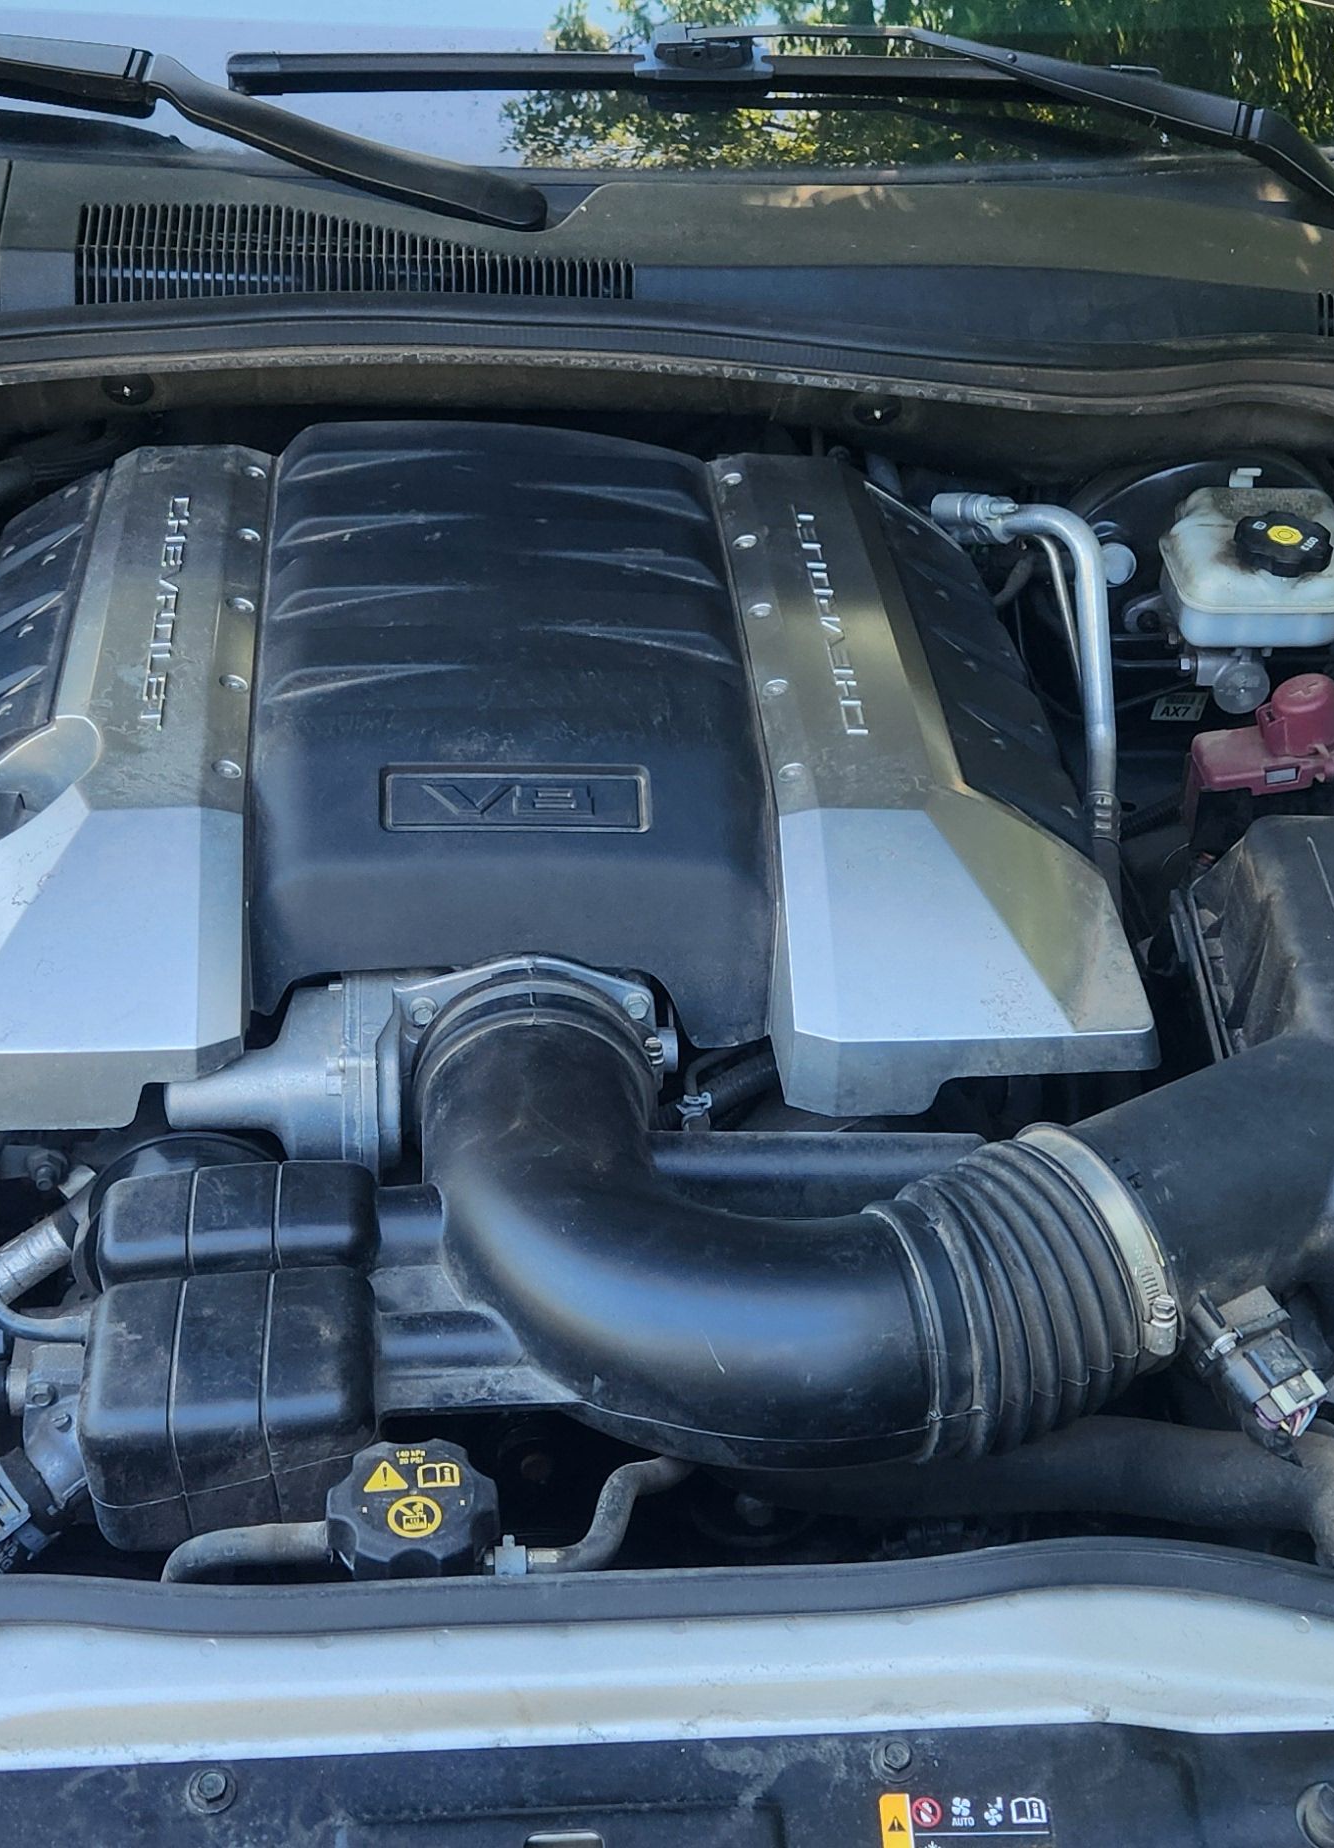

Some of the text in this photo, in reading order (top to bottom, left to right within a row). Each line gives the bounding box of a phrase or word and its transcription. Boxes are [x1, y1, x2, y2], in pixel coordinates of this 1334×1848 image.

[141, 497, 190, 731] CHEVROLET
[791, 504, 869, 735] CHEVROLET
[1160, 706, 1192, 718] AX7
[421, 784, 595, 816] V8
[951, 1816, 975, 1827] AUTO
